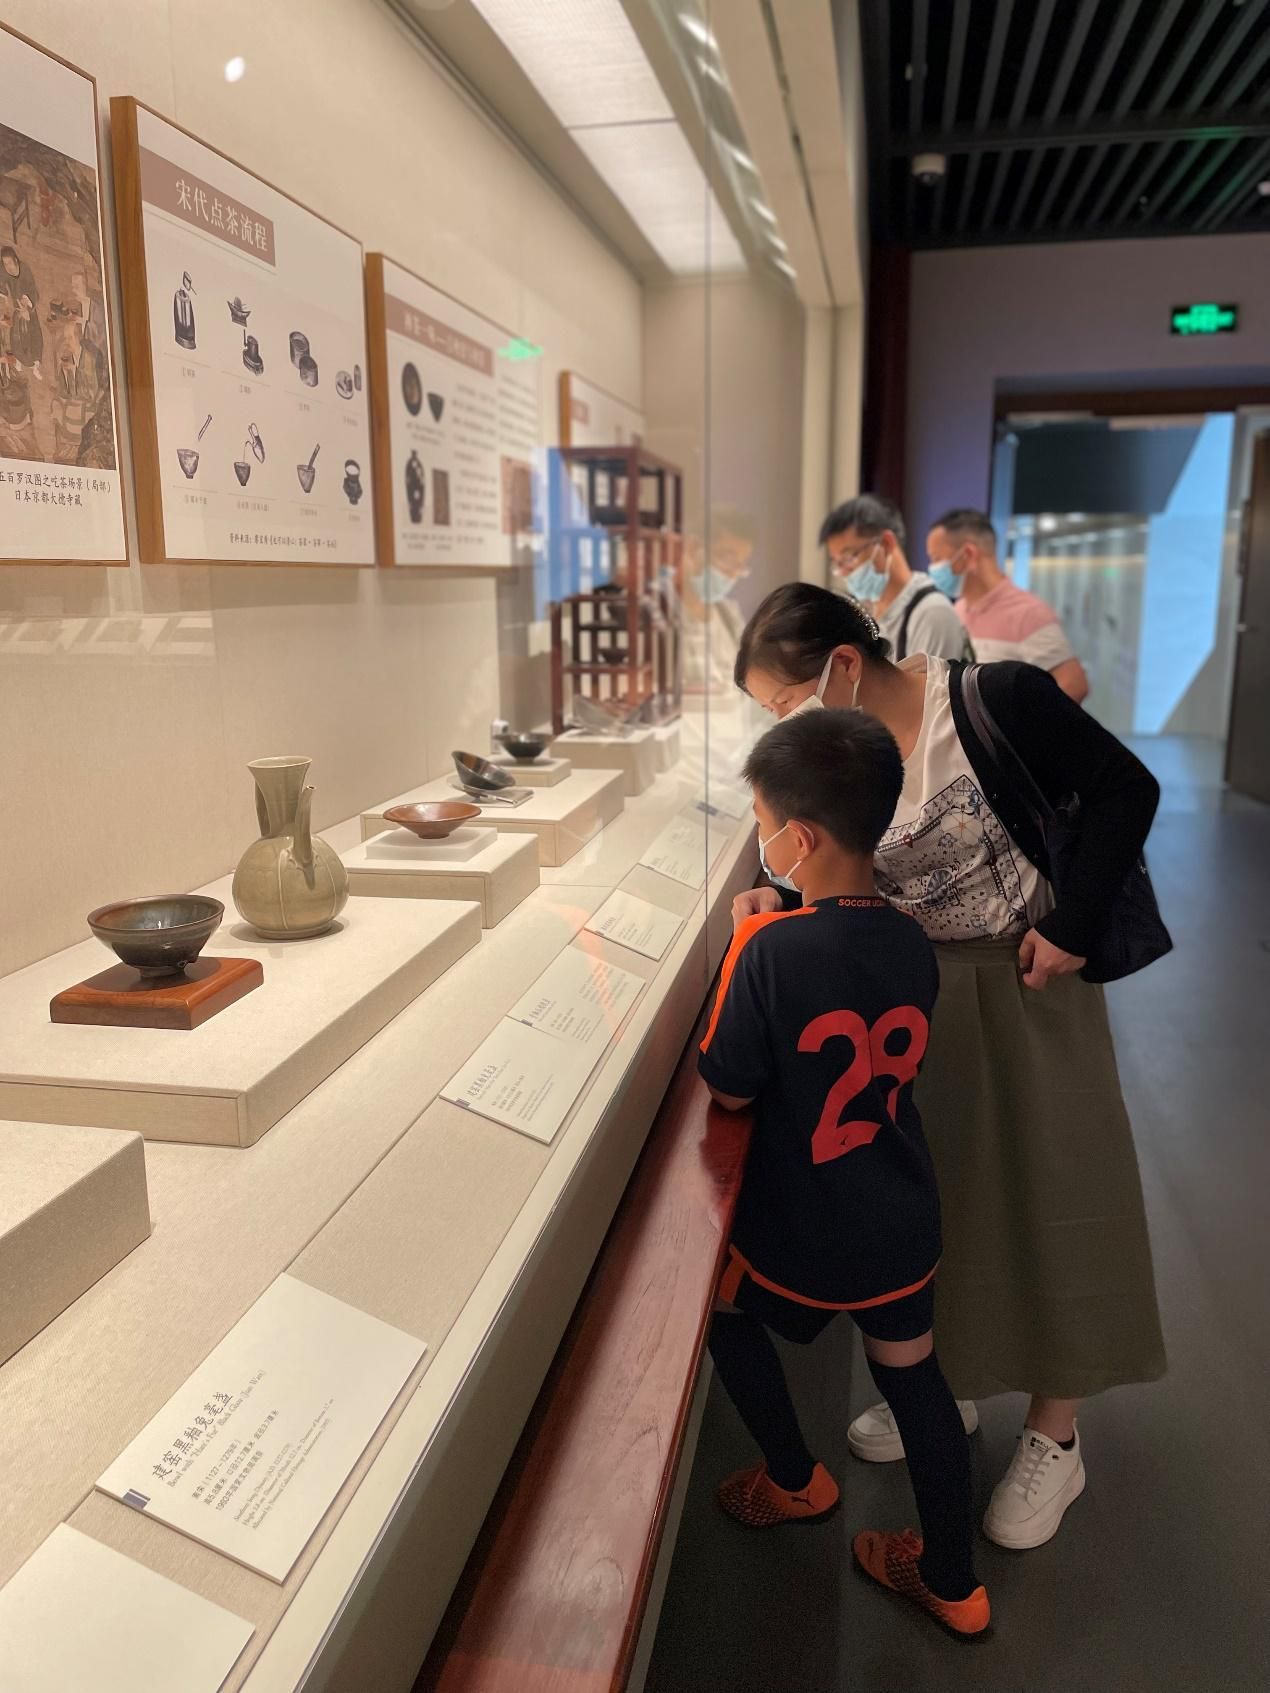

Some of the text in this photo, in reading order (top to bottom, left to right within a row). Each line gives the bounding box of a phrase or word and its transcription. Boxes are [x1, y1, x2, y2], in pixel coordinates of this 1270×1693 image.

[175, 179, 268, 252] 宋代点茶流程
[838, 898, 871, 907] SOCCER
[152, 1391, 233, 1480] 建窑黑釉兔毫盏
[166, 1471, 184, 1487] Bowl
